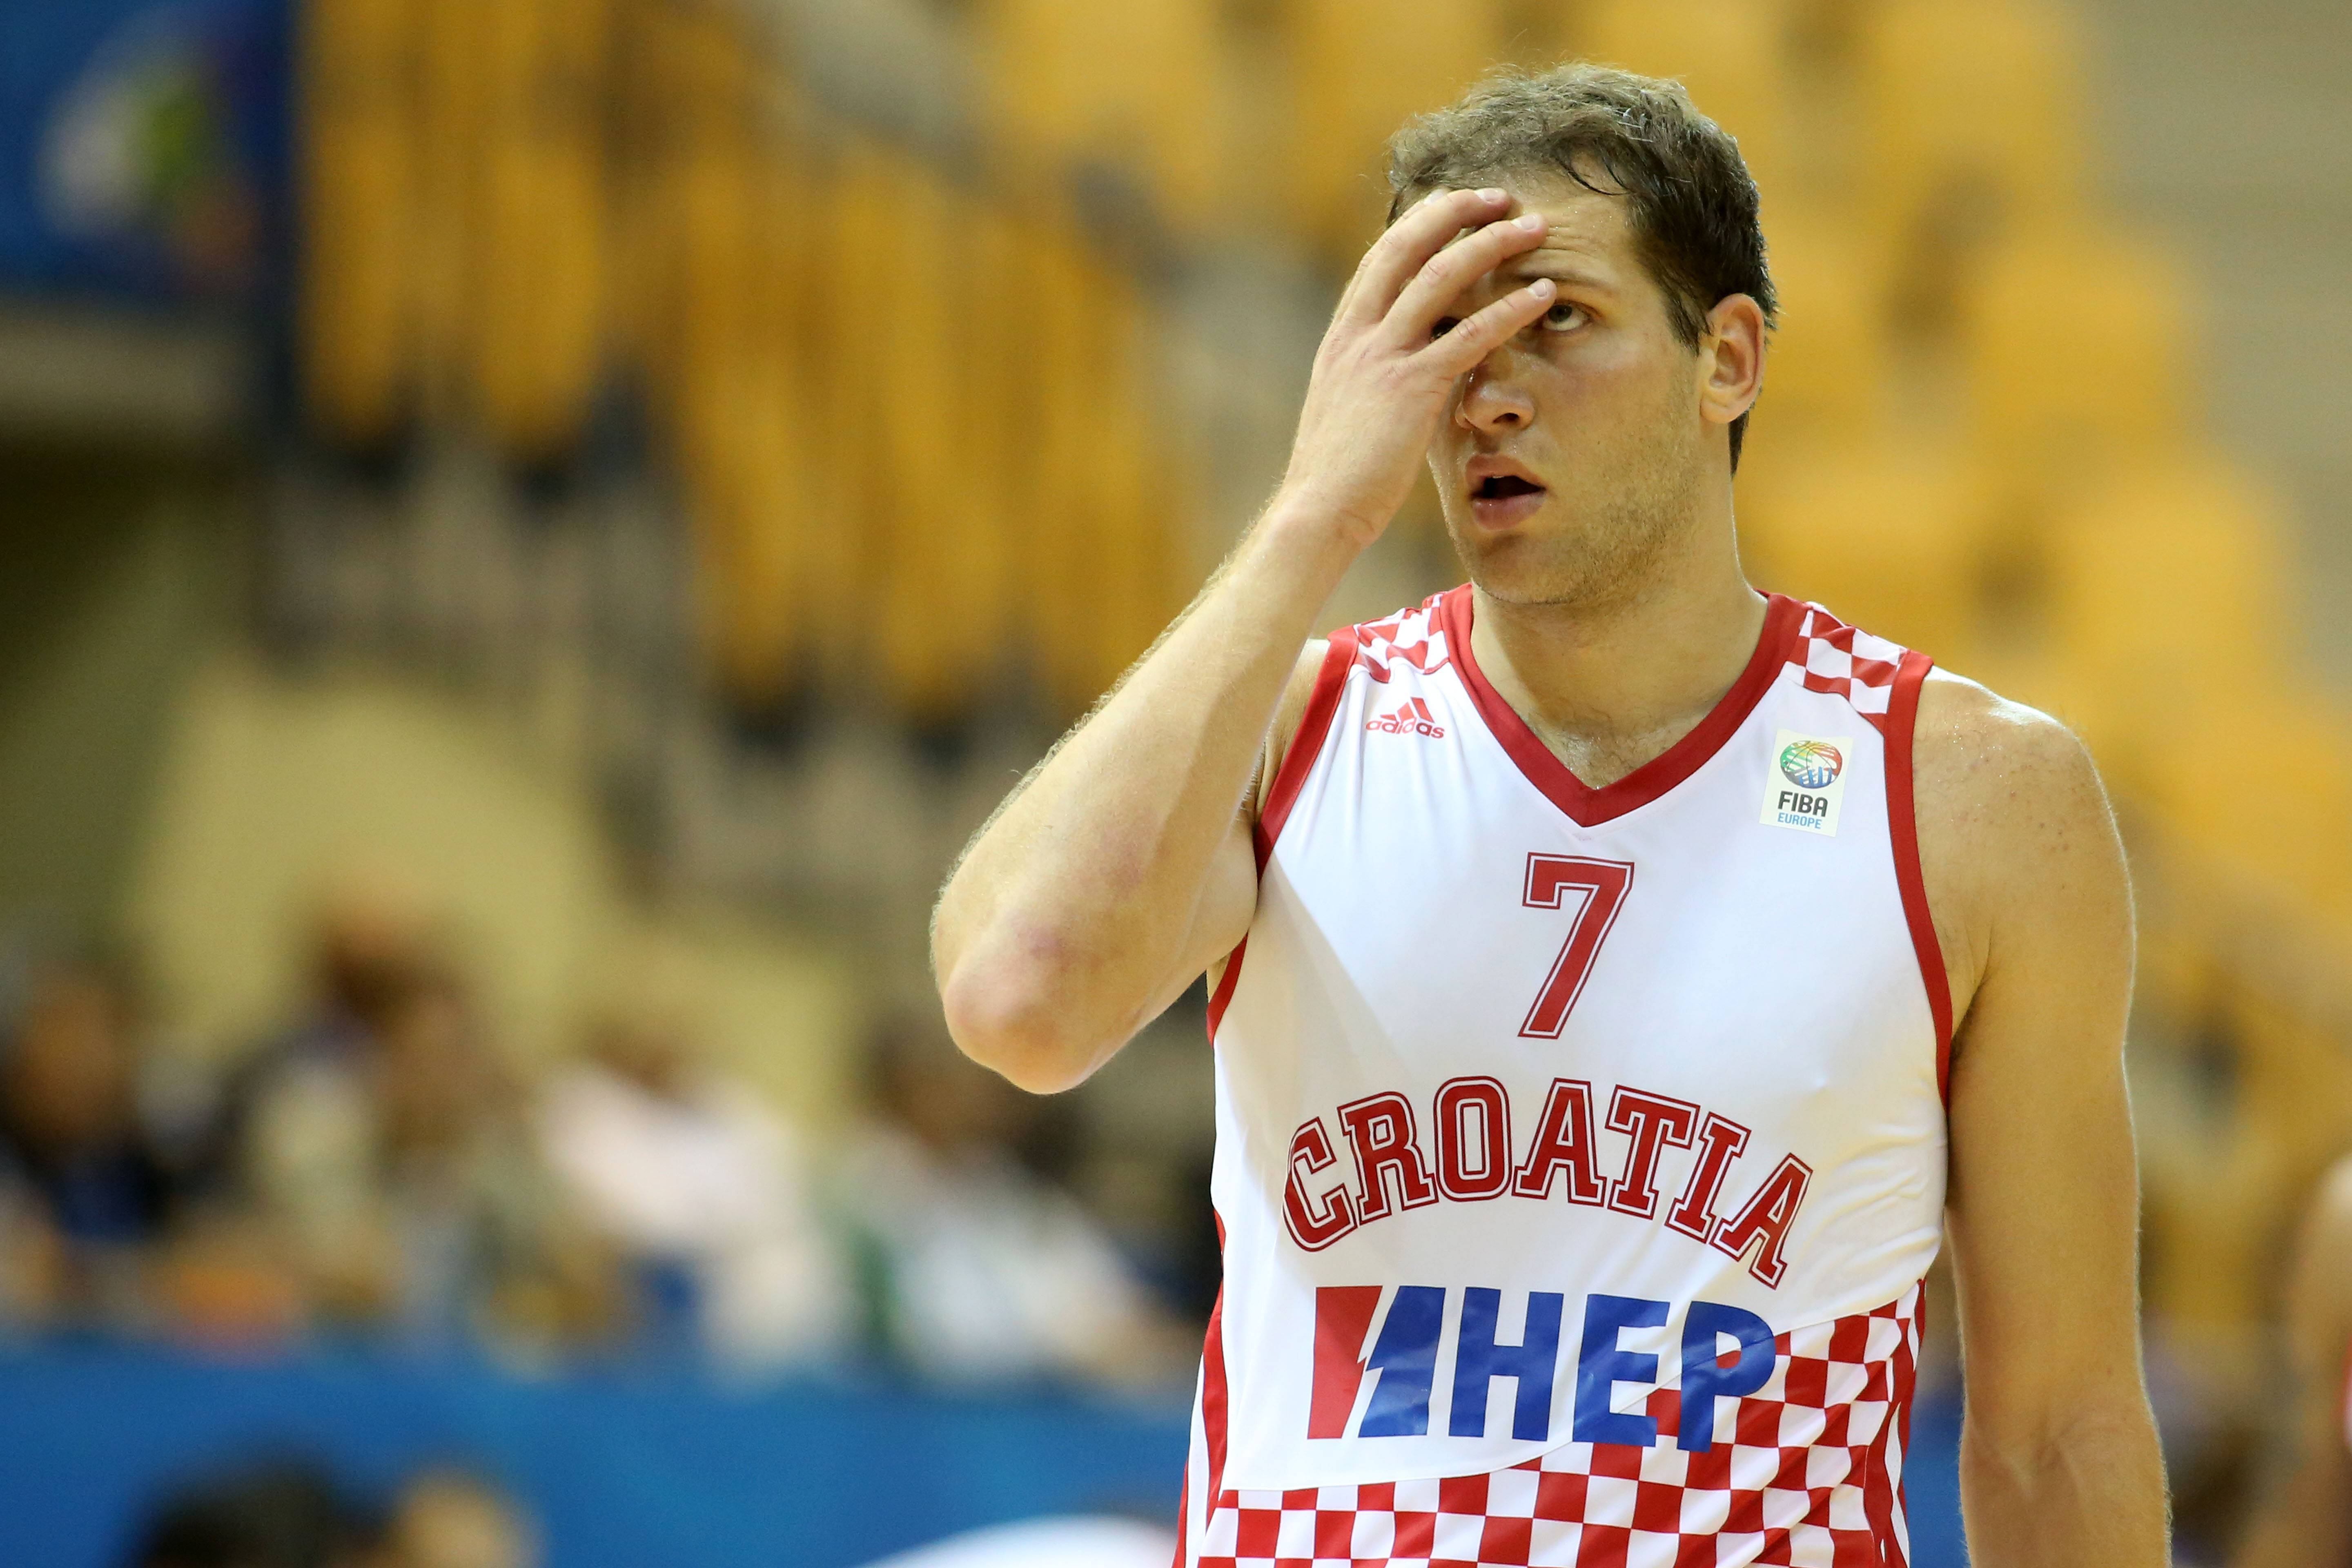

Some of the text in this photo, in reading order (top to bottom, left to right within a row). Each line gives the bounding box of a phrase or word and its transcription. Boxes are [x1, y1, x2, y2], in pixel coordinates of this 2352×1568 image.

[1365, 717, 1445, 739] adidas
[1777, 790, 1829, 817] FIBA
[1777, 812, 1822, 829] EUROPE
[1517, 852, 1635, 1039] 7
[1283, 1076, 1813, 1290] CROATIA
[1448, 1287, 1776, 1452] HEP
